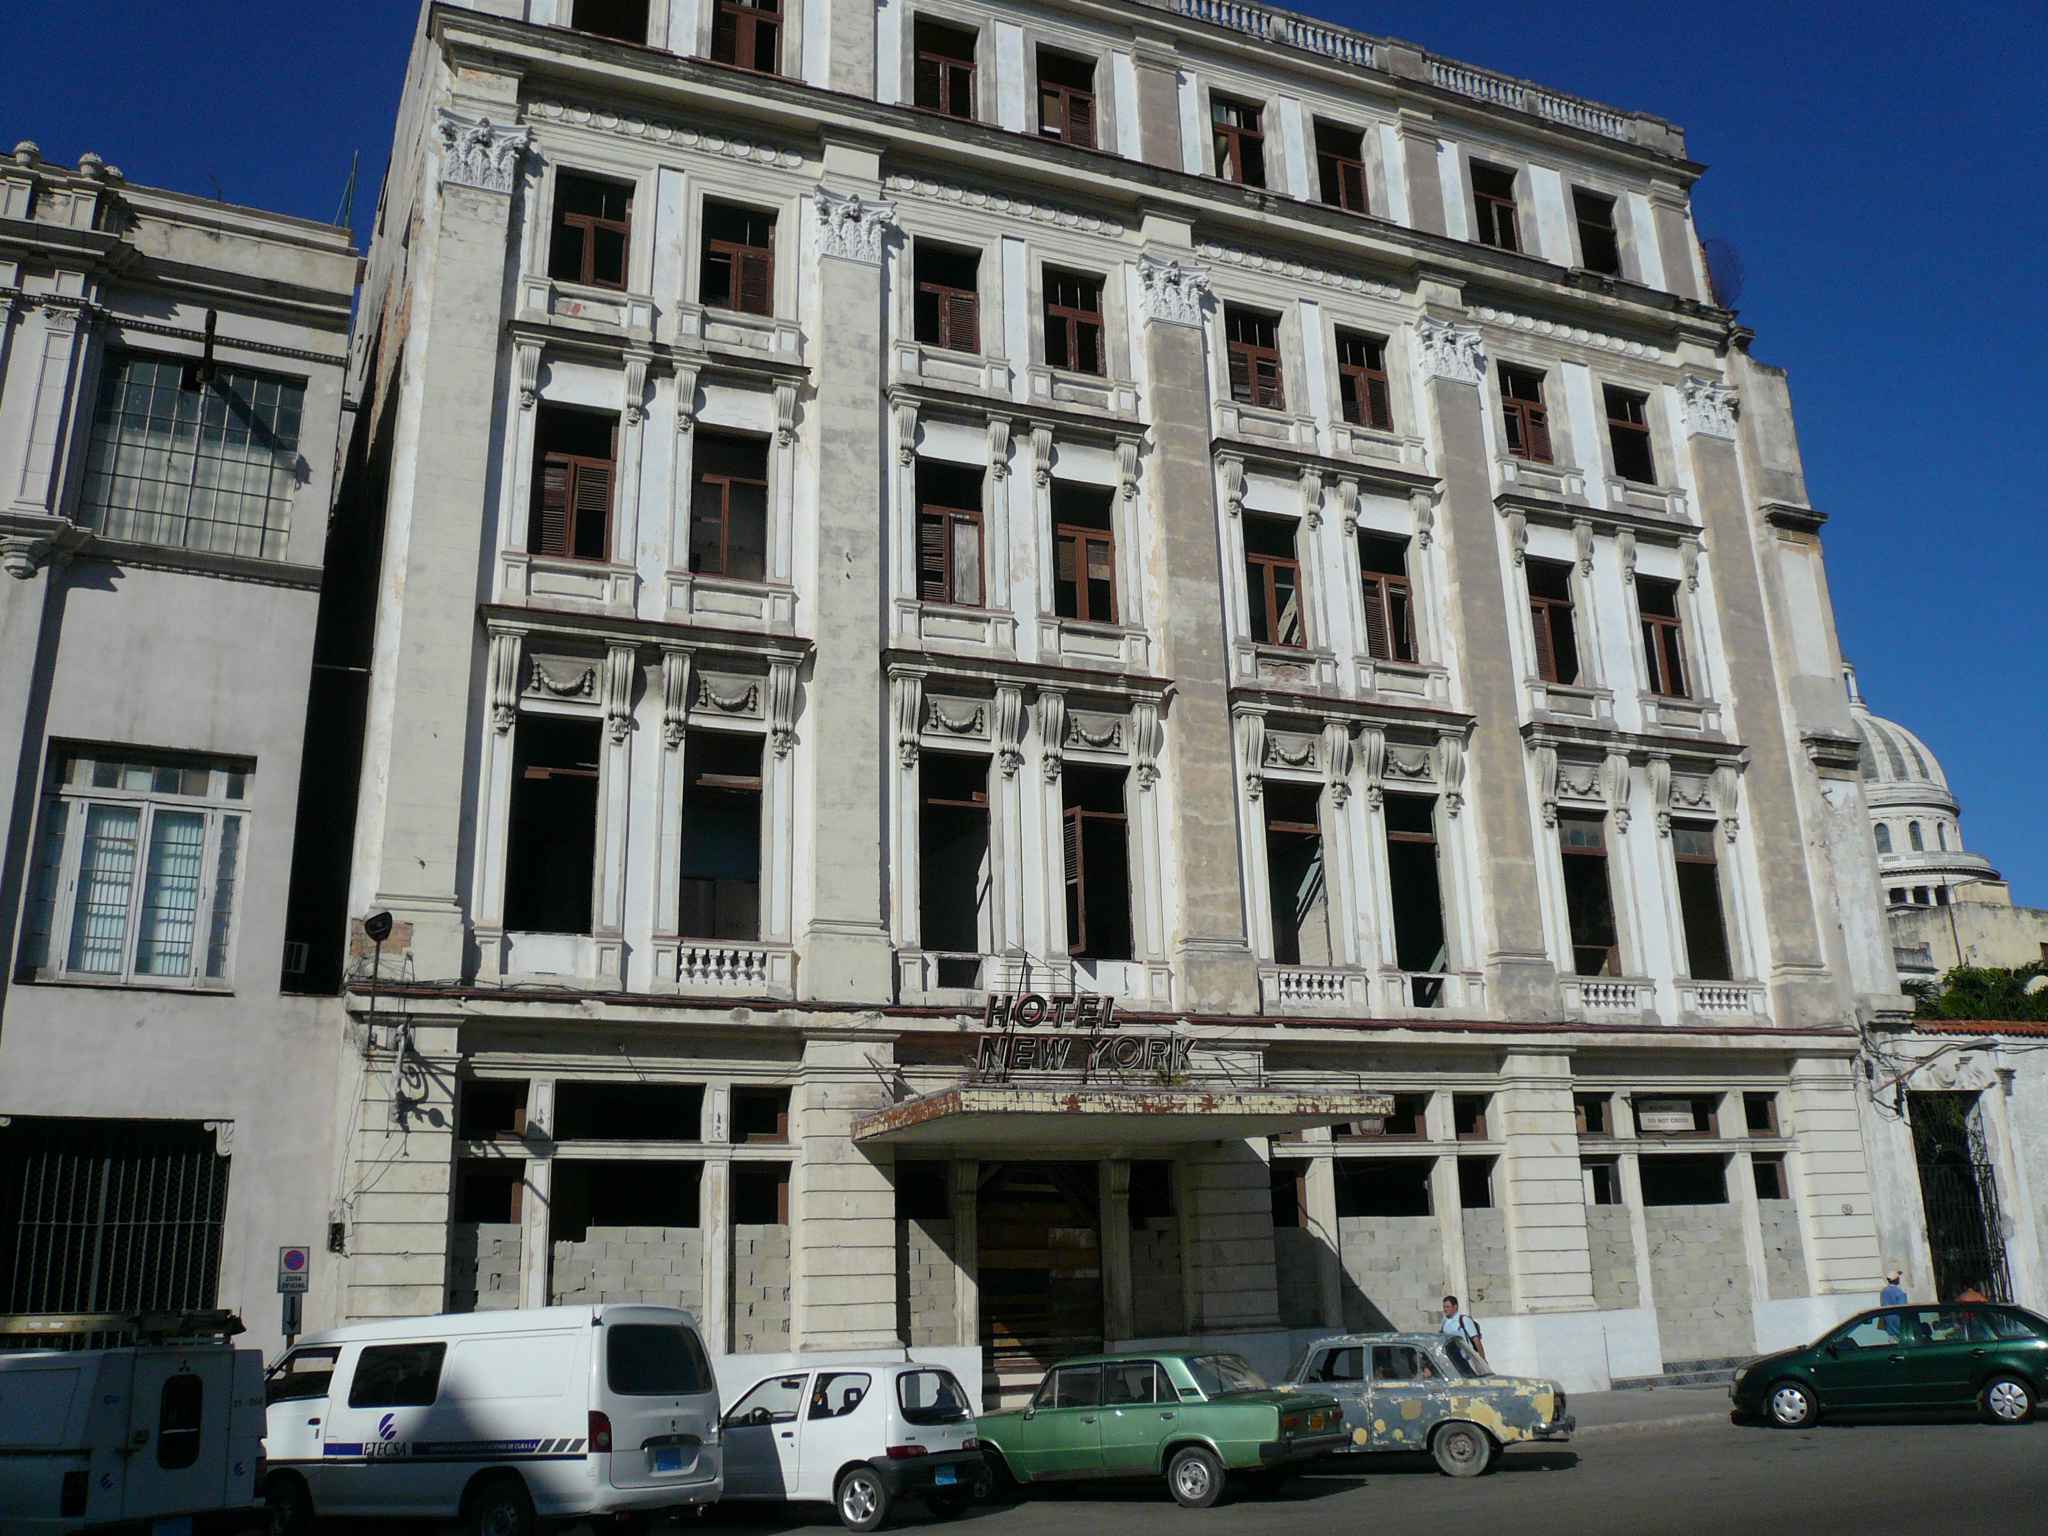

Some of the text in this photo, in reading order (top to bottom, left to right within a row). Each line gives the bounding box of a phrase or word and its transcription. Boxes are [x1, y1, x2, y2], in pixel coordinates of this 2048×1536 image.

[984, 993, 1121, 1028] HOTEL
[977, 1035, 1198, 1071] NEW YORK
[363, 1441, 411, 1456] ETECSA
